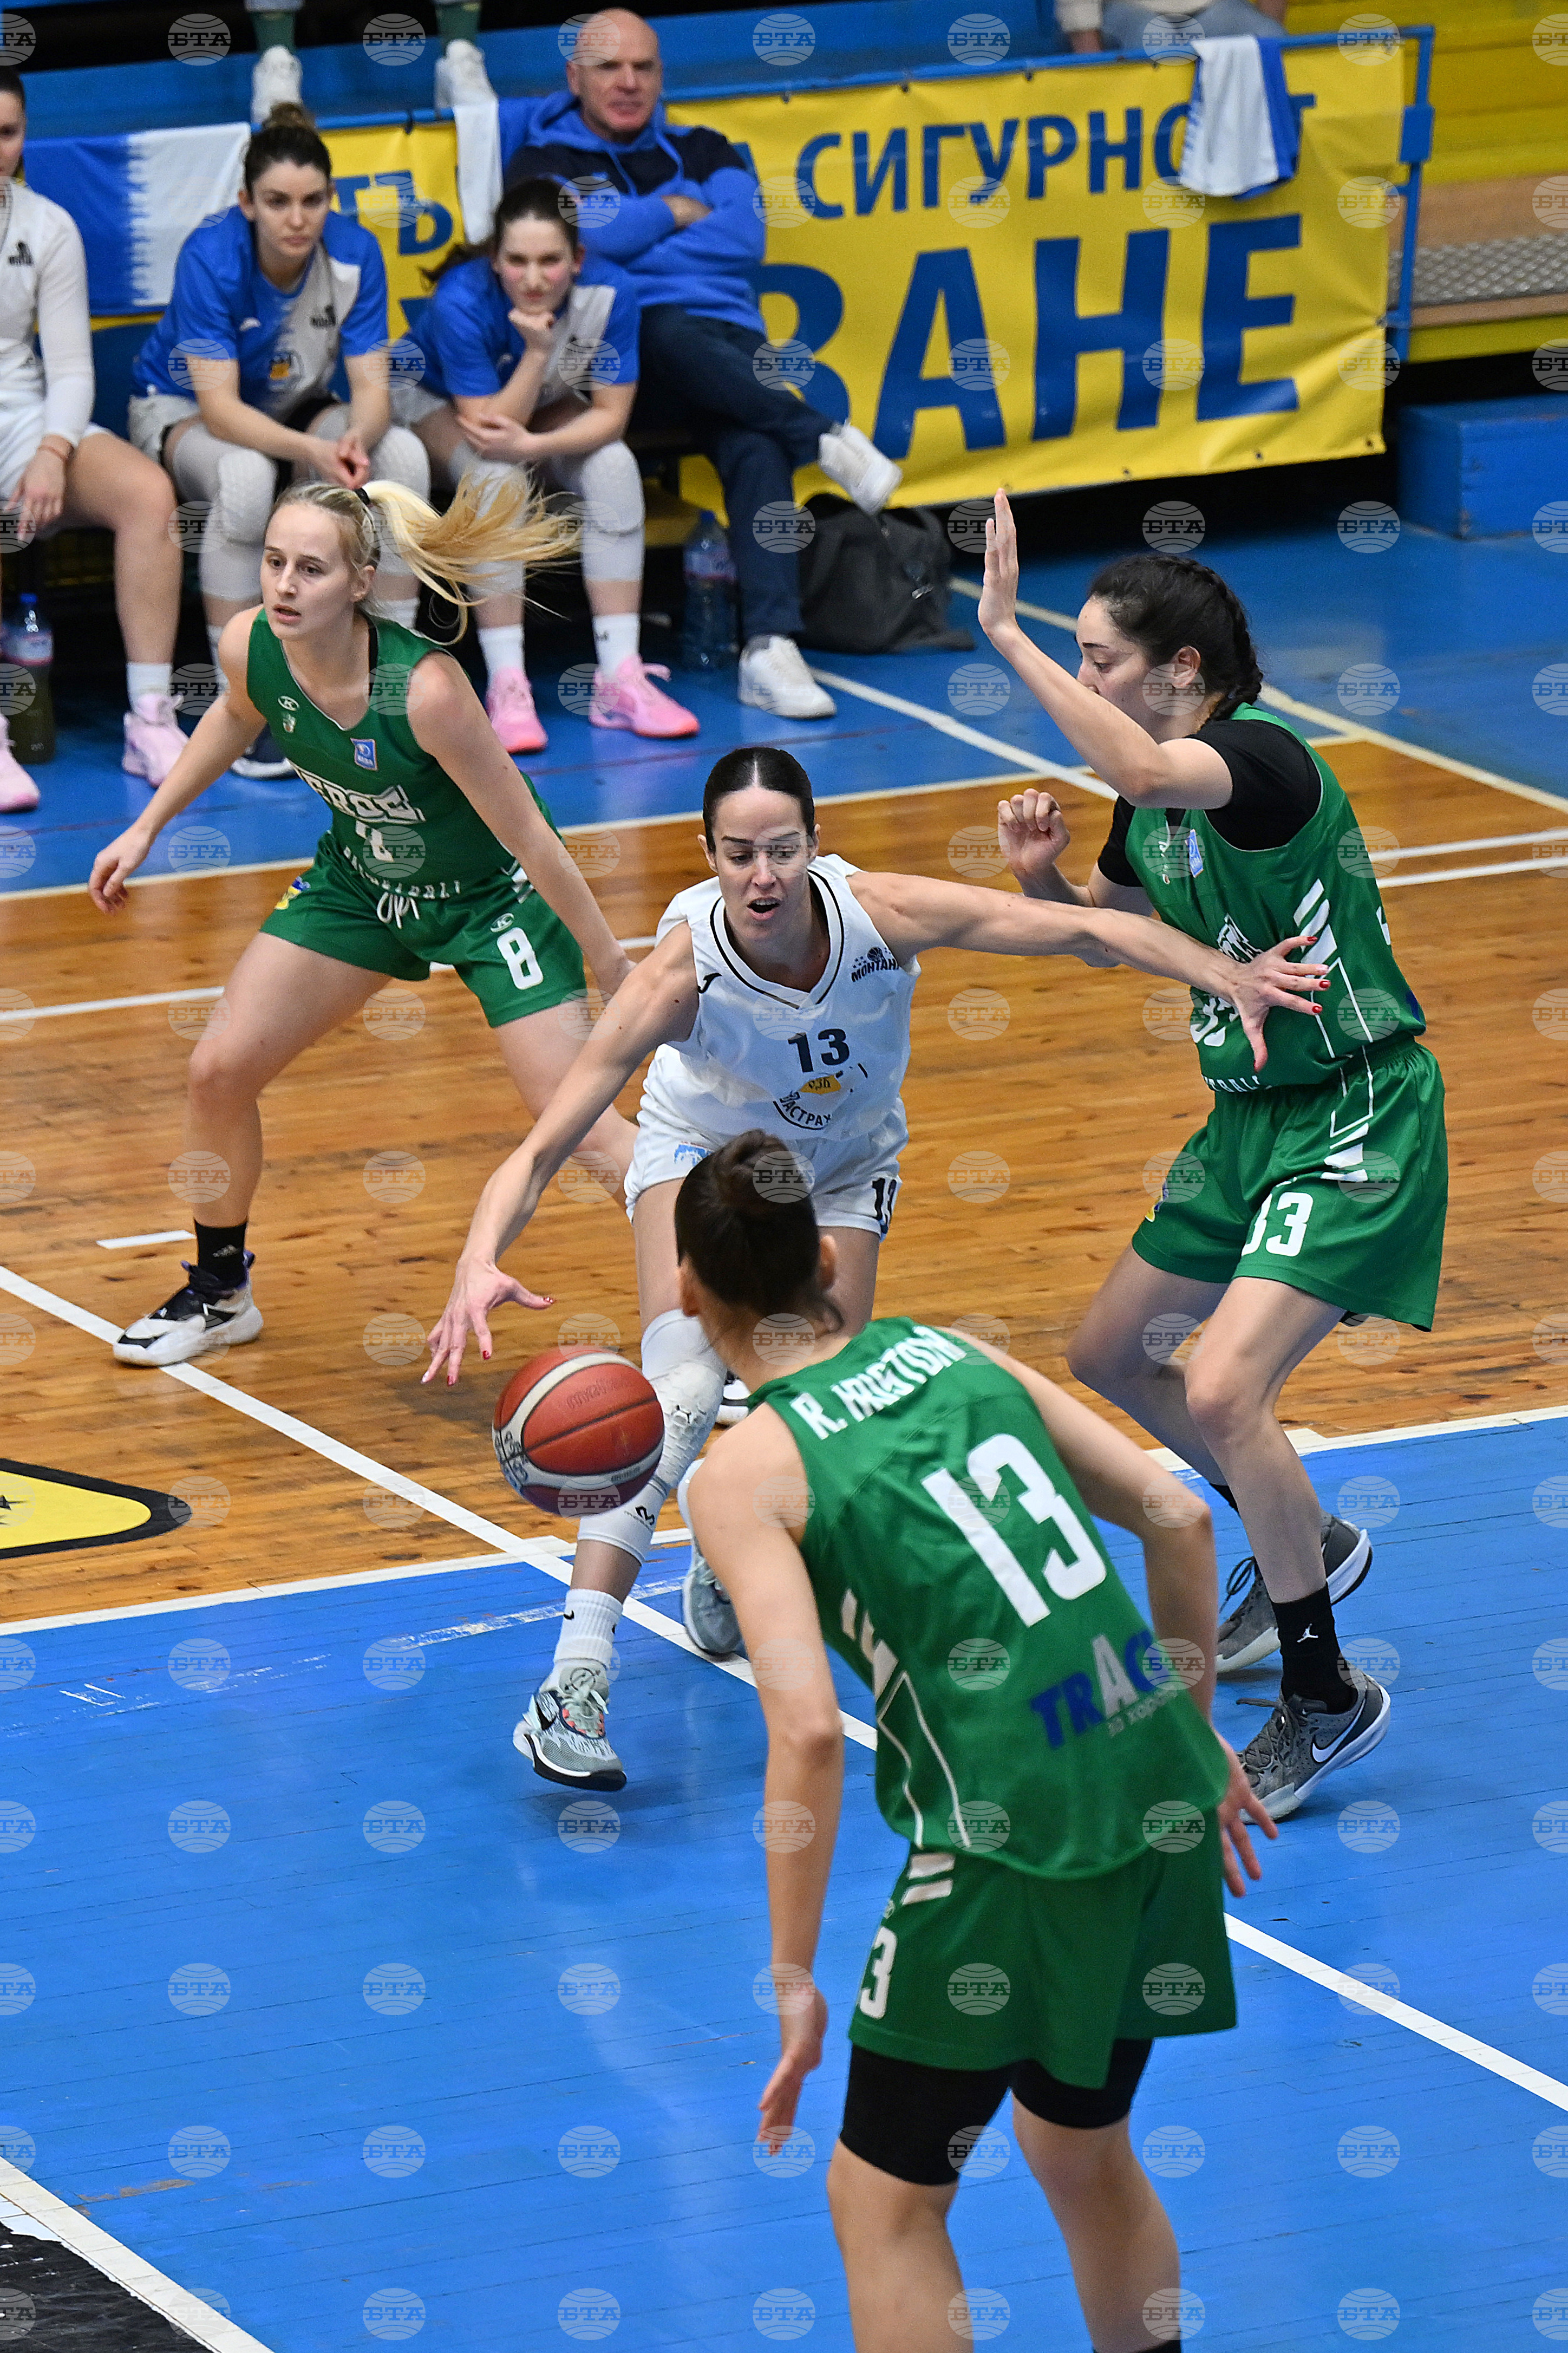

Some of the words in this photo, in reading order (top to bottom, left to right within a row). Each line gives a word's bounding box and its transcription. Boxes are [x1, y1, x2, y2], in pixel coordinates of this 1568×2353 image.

[496, 927, 544, 990] 8
[787, 1028, 850, 1073] 13
[789, 1392, 848, 1440] R.
[921, 1433, 1107, 1628] 13
